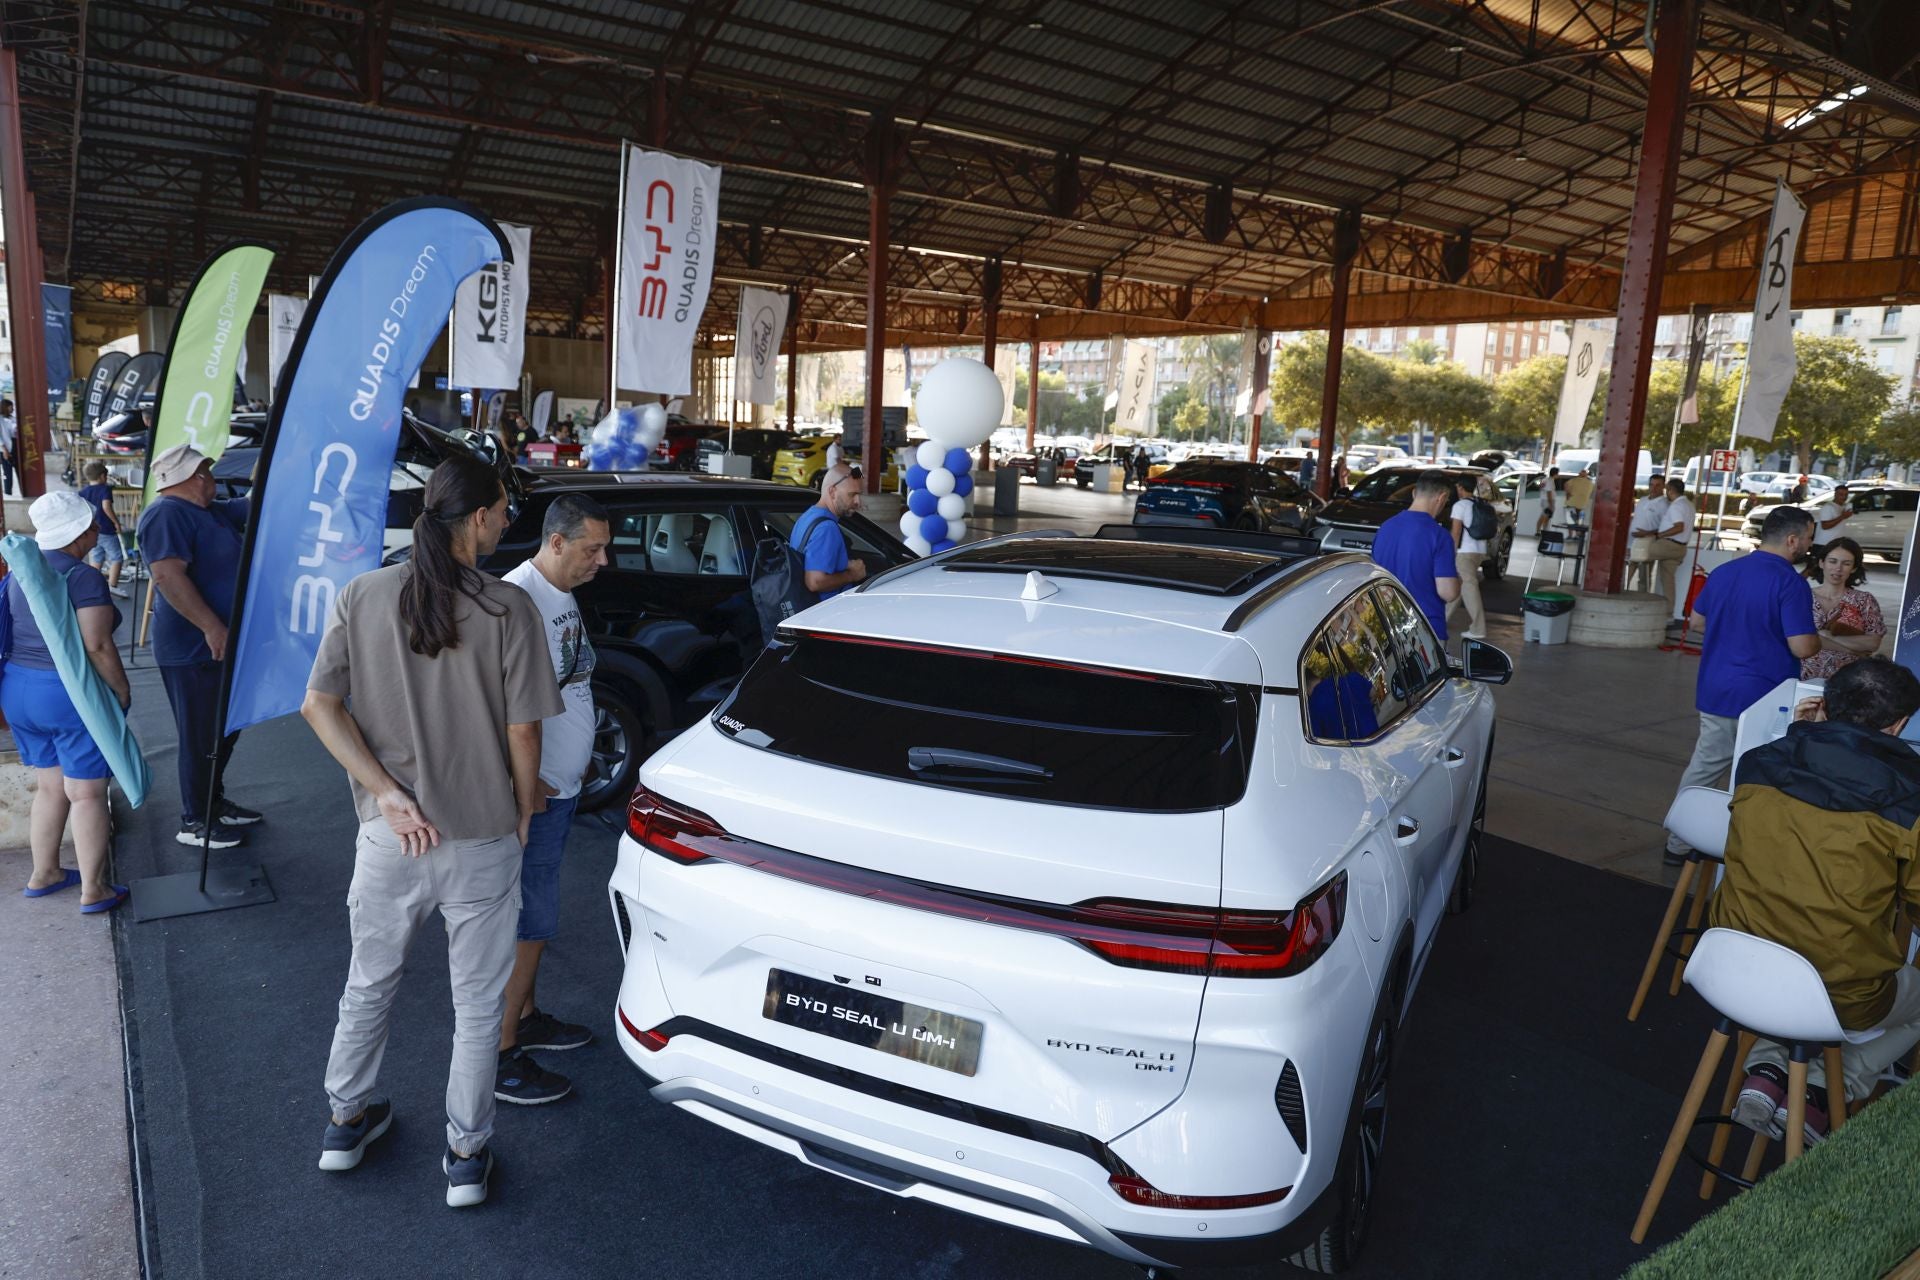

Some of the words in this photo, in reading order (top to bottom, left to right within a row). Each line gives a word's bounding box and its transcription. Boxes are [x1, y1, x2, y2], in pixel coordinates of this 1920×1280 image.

[685, 185, 705, 246] Dream
[638, 179, 674, 320] BYD
[499, 284, 511, 344] AUTOPISTA
[675, 249, 700, 323] QUADIS
[204, 317, 233, 380] QUADIS
[220, 271, 241, 315] Dream
[349, 317, 401, 422] QUADIS
[390, 243, 437, 319] Dream
[754, 320, 772, 366] Ford
[88, 367, 108, 416] EBRO
[289, 441, 358, 635] BYD
[552, 612, 568, 627] VAN
[719, 715, 746, 731] QUADIS
[786, 993, 828, 1014] BYD
[832, 1006, 887, 1031] SEAL
[892, 1022, 907, 1037] U
[912, 1027, 956, 1050] DM-i
[1047, 1038, 1090, 1052] BYD
[1096, 1045, 1154, 1059] SEAL
[1159, 1052, 1174, 1061] U
[1135, 1063, 1174, 1073] DM-i
